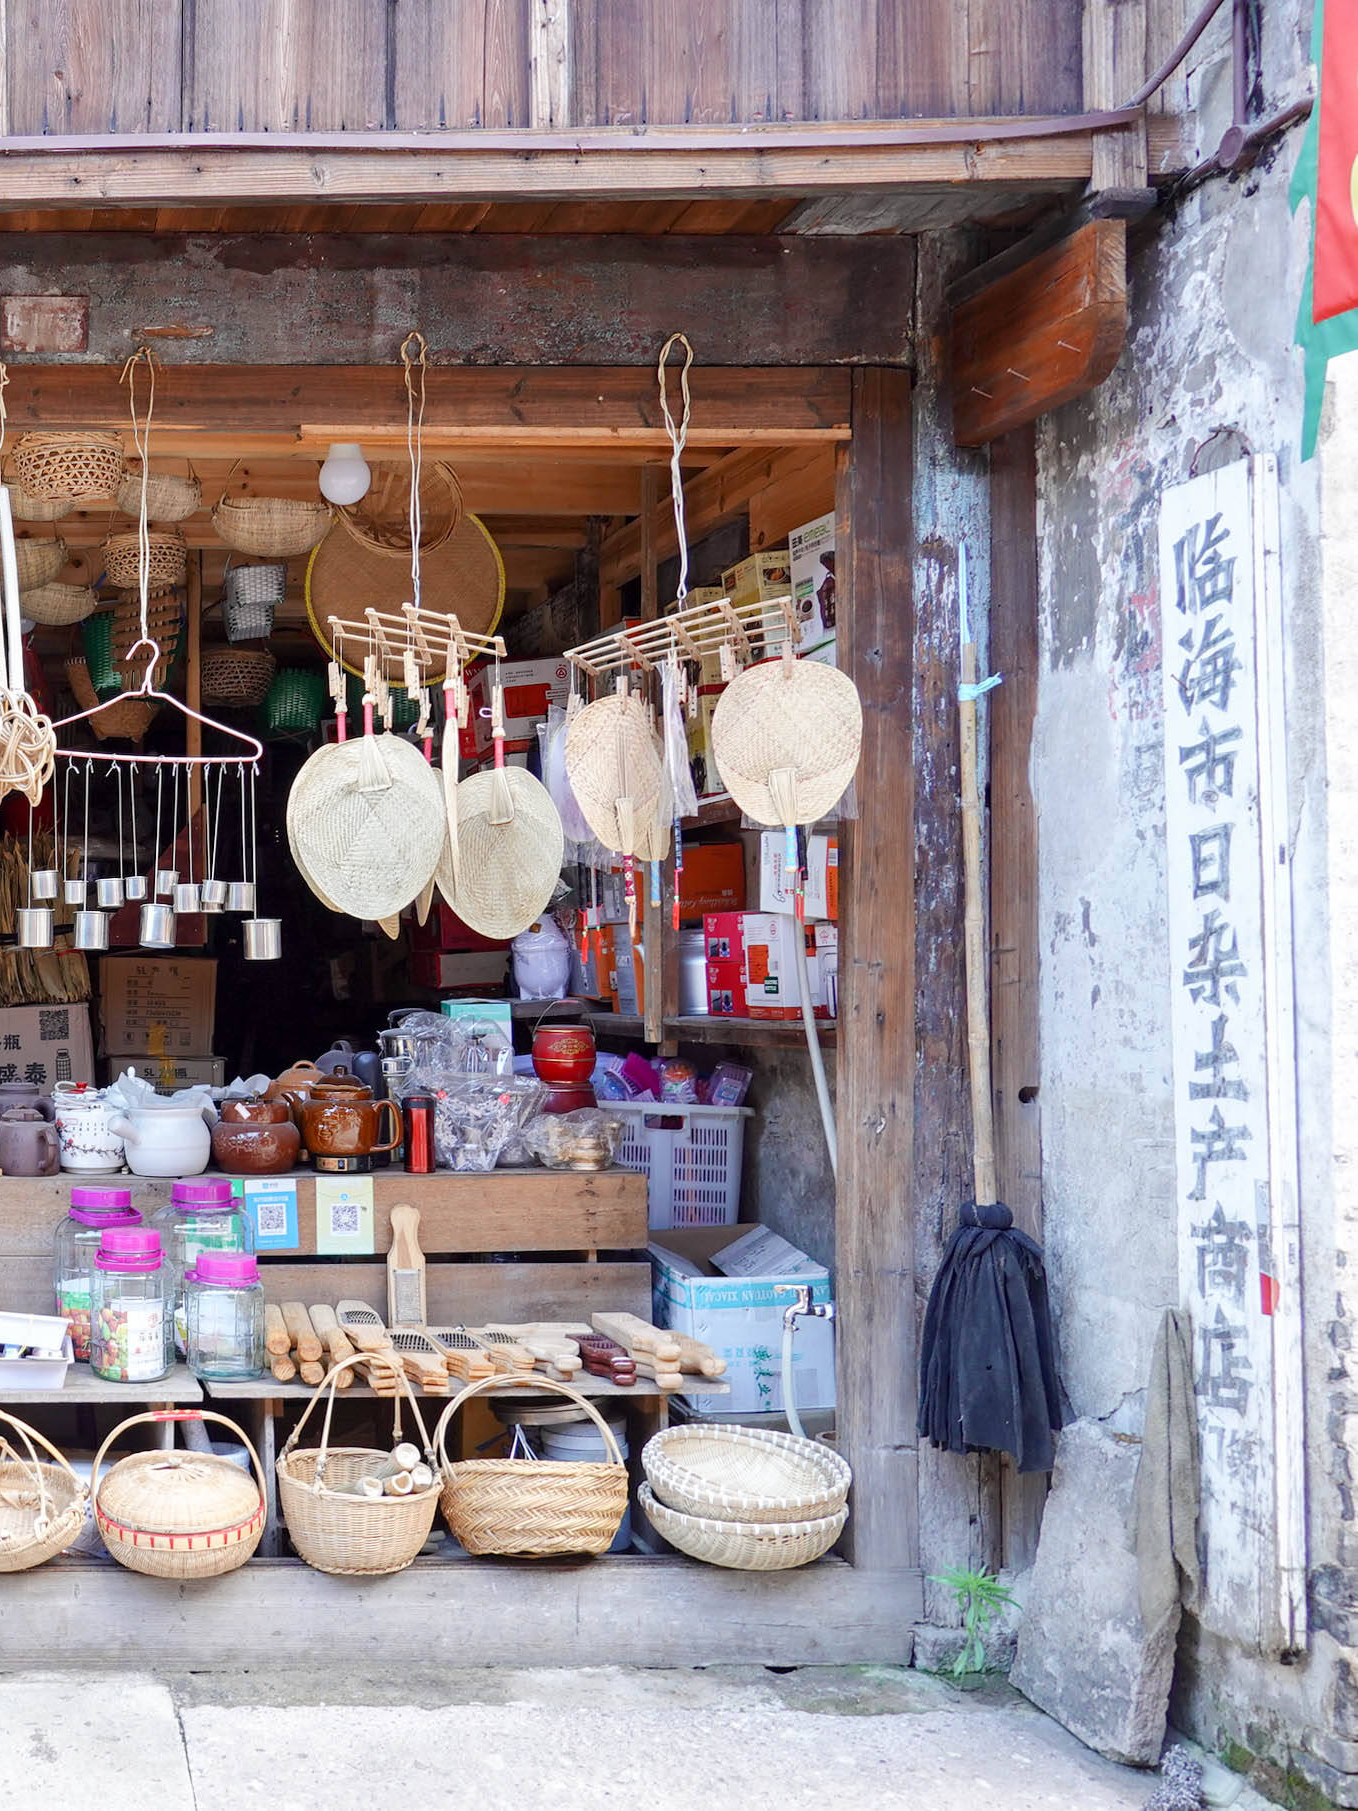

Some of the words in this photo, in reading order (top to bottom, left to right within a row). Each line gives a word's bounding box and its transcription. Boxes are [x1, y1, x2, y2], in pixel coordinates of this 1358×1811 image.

[1172, 511, 1254, 1417] 临海市日杂土产商店
